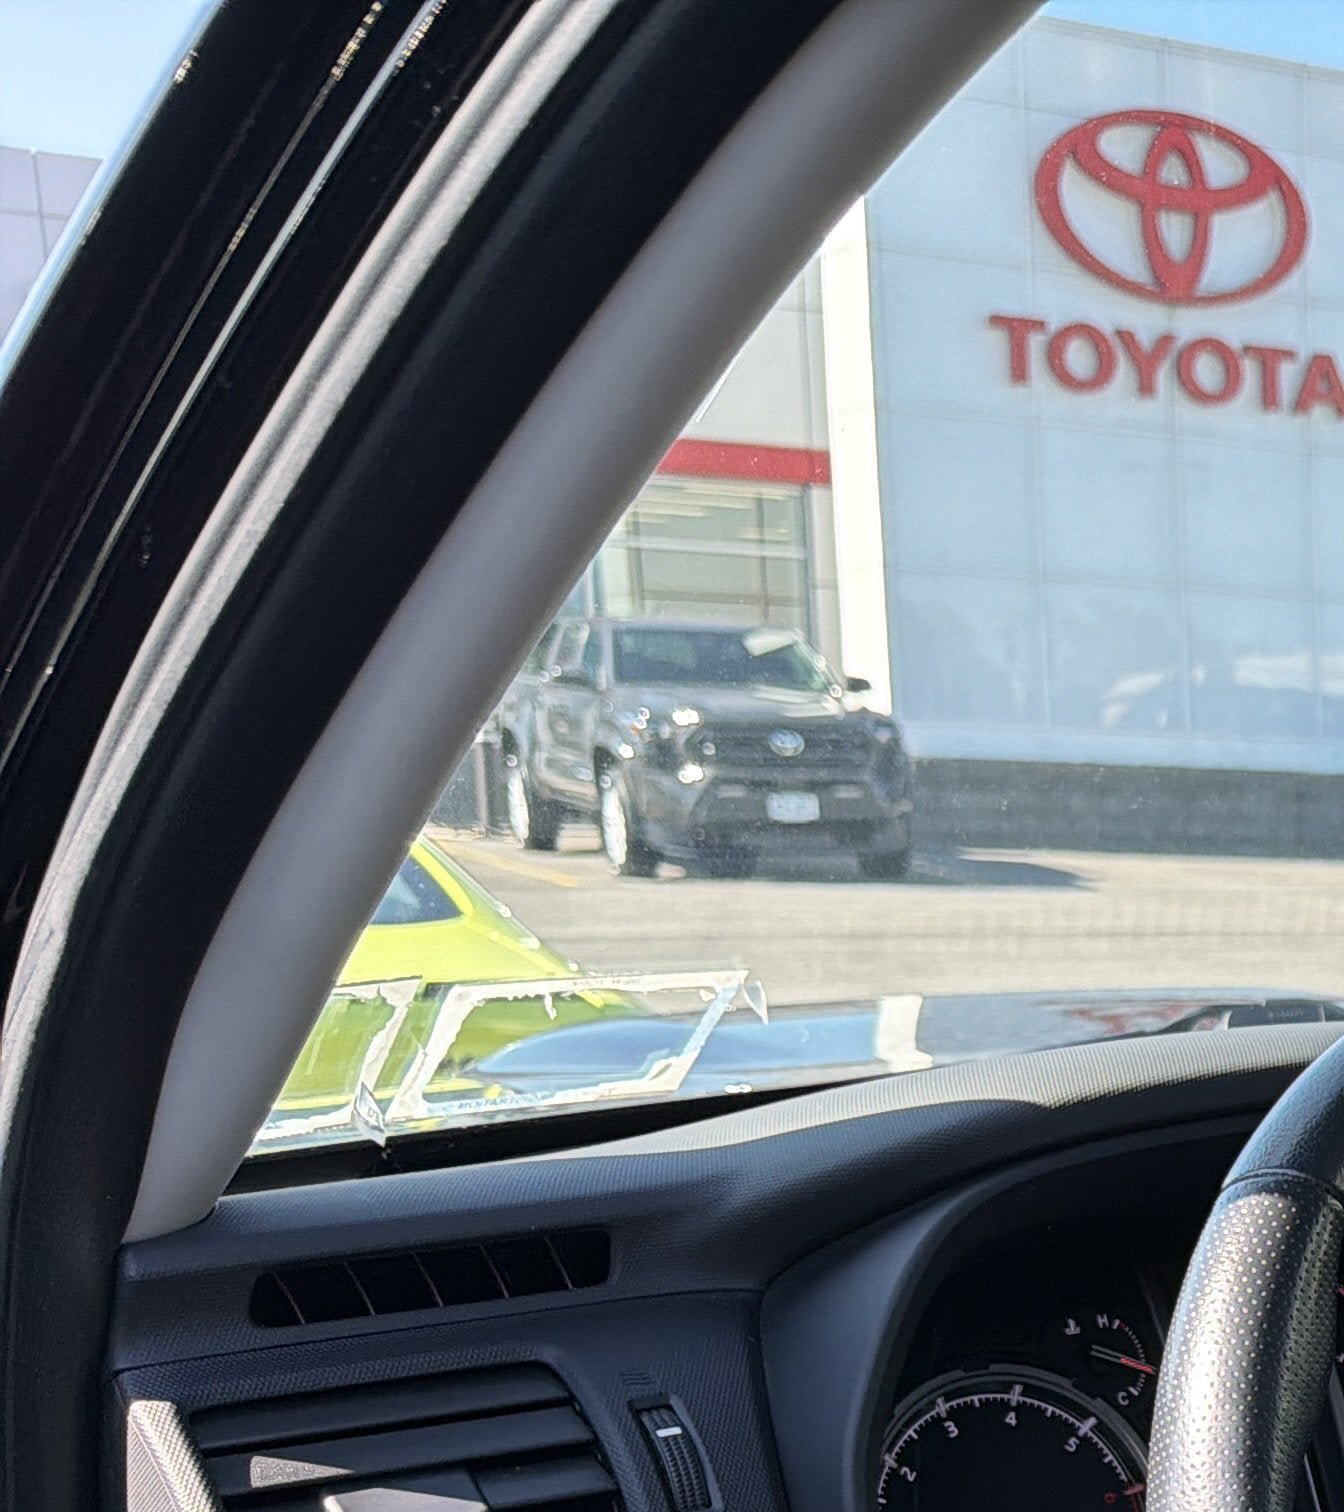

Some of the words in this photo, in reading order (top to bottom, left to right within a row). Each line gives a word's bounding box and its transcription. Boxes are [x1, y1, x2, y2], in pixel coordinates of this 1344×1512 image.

[1004, 1411, 1018, 1428] 4
[943, 1420, 959, 1438] 3
[1064, 1437, 1081, 1453] 5
[900, 1466, 918, 1483] 2
